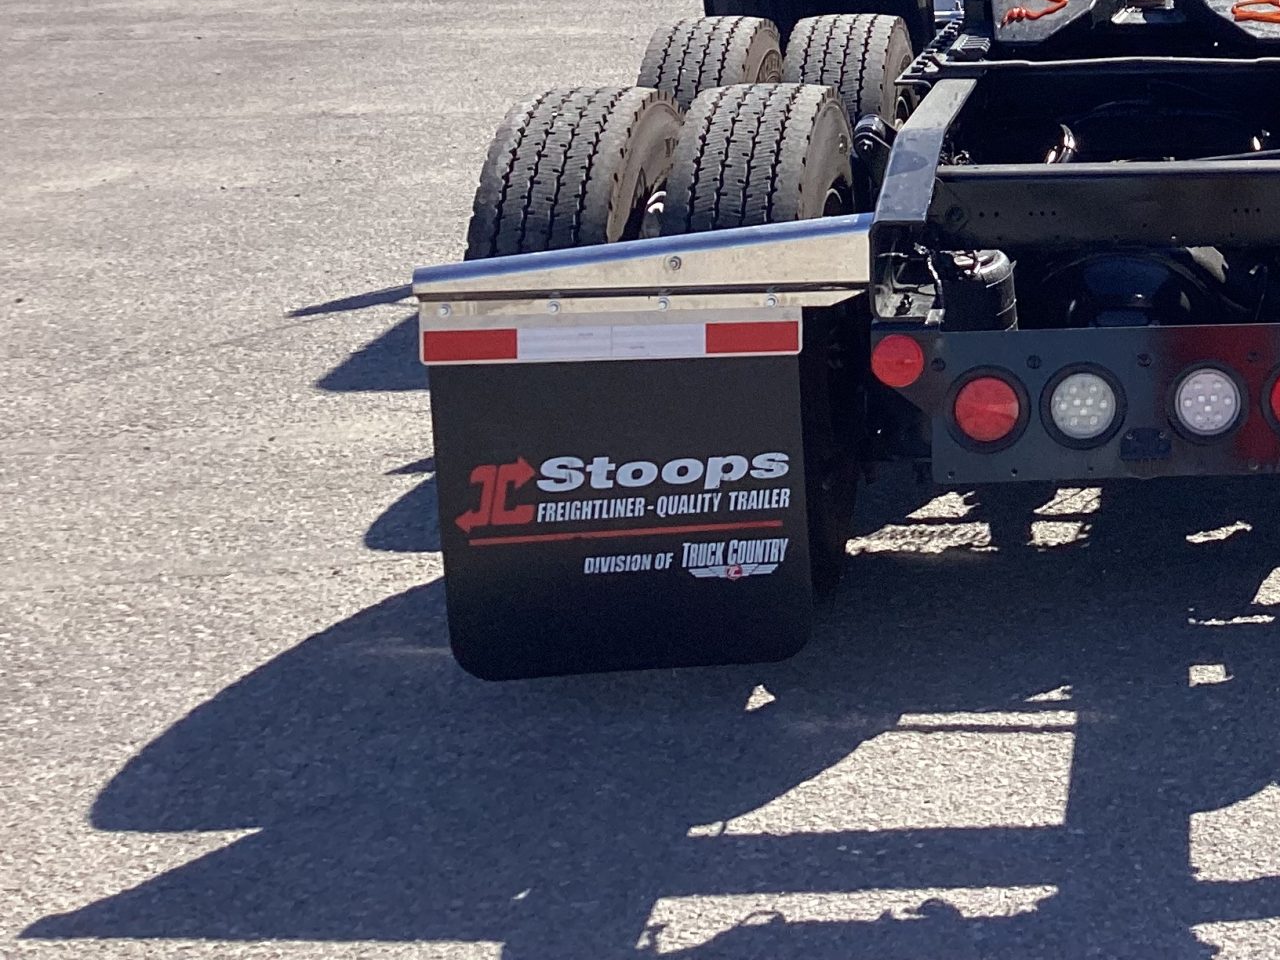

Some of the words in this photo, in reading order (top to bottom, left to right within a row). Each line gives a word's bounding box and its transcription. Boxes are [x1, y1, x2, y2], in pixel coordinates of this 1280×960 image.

[536, 452, 790, 492] Stoops
[728, 488, 791, 511] TRAILER
[584, 554, 651, 574] DIVISION
[654, 552, 674, 570] OF
[682, 542, 725, 568] TRUCK
[727, 538, 789, 565] COUNTRY
